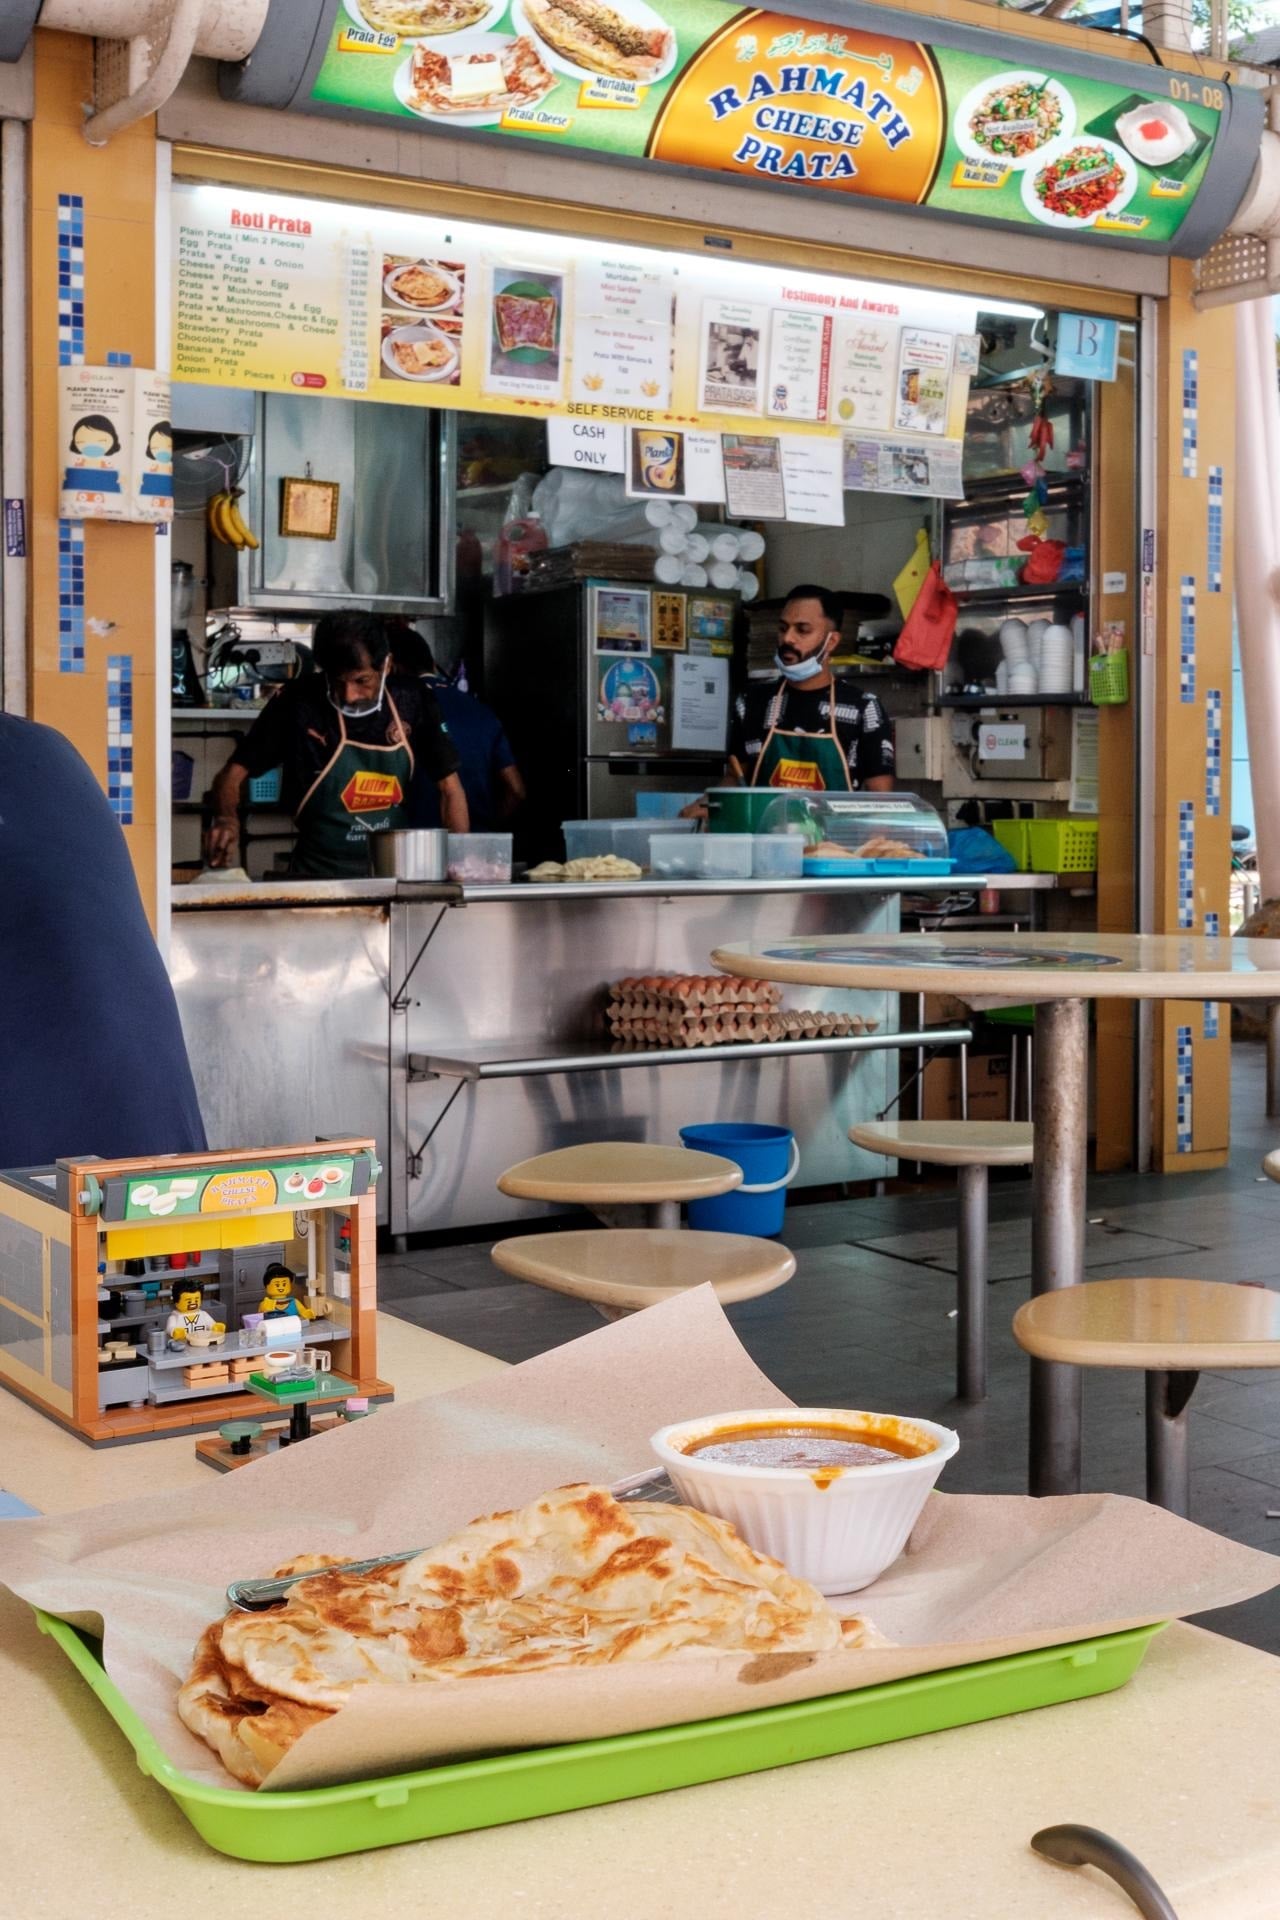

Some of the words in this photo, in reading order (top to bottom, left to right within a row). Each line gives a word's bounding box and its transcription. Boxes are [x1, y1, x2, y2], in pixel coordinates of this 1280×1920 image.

[346, 28, 374, 43] Prata
[378, 32, 396, 48] Egg
[597, 77, 636, 94] Murtabak
[1169, 78, 1225, 110] 01-08
[509, 107, 534, 122] Prata
[537, 113, 567, 126] Cheese
[709, 67, 910, 148] RAHMATH
[756, 108, 864, 145] CHEESE
[985, 124, 1001, 134] Not
[1002, 121, 1036, 132] Available
[736, 136, 855, 177] PRATA
[1056, 182, 1072, 191] Not
[1073, 166, 1108, 186] Available
[231, 209, 263, 228] Roti
[268, 214, 312, 235] Prata
[180, 226, 203, 237] Plain
[207, 229, 232, 241] Prata
[242, 233, 260, 244] Min
[180, 237, 198, 249] Egg
[207, 240, 233, 251] Prata
[179, 259, 215, 270] Cheese
[223, 263, 249, 274] Prata
[180, 248, 206, 258] Prata
[231, 254, 250, 265] Egg
[259, 257, 266, 265] &
[274, 259, 304, 270] Onion
[179, 270, 214, 280] Cheese
[223, 274, 247, 284] Prata
[271, 279, 289, 291] Egg
[179, 280, 204, 290] Prata
[227, 285, 282, 299] Mushrooms
[179, 290, 204, 301] Prata
[227, 295, 282, 309] Mushrooms
[303, 304, 322, 314] Egg
[862, 299, 899, 316] Awards
[178, 301, 203, 312] Prata
[320, 315, 338, 326] Egg
[178, 311, 203, 322] Prata
[226, 317, 280, 330] Mushrooms
[288, 323, 294, 331] &
[302, 325, 336, 335] Cheese
[178, 322, 230, 335] Strawberry
[238, 328, 263, 338] Prata
[1076, 319, 1098, 356] B
[177, 333, 225, 345] Chocolate
[233, 338, 258, 348] Prata
[177, 343, 213, 354] Banana
[221, 347, 245, 357] Prata
[177, 354, 206, 364] Onion
[214, 357, 238, 367] Prata
[176, 364, 210, 375] Appam
[244, 369, 275, 381] Pieces
[567, 403, 597, 417] SELF
[602, 406, 654, 421] SERVICE
[573, 424, 605, 440] CASH
[574, 450, 607, 465] ONLY
